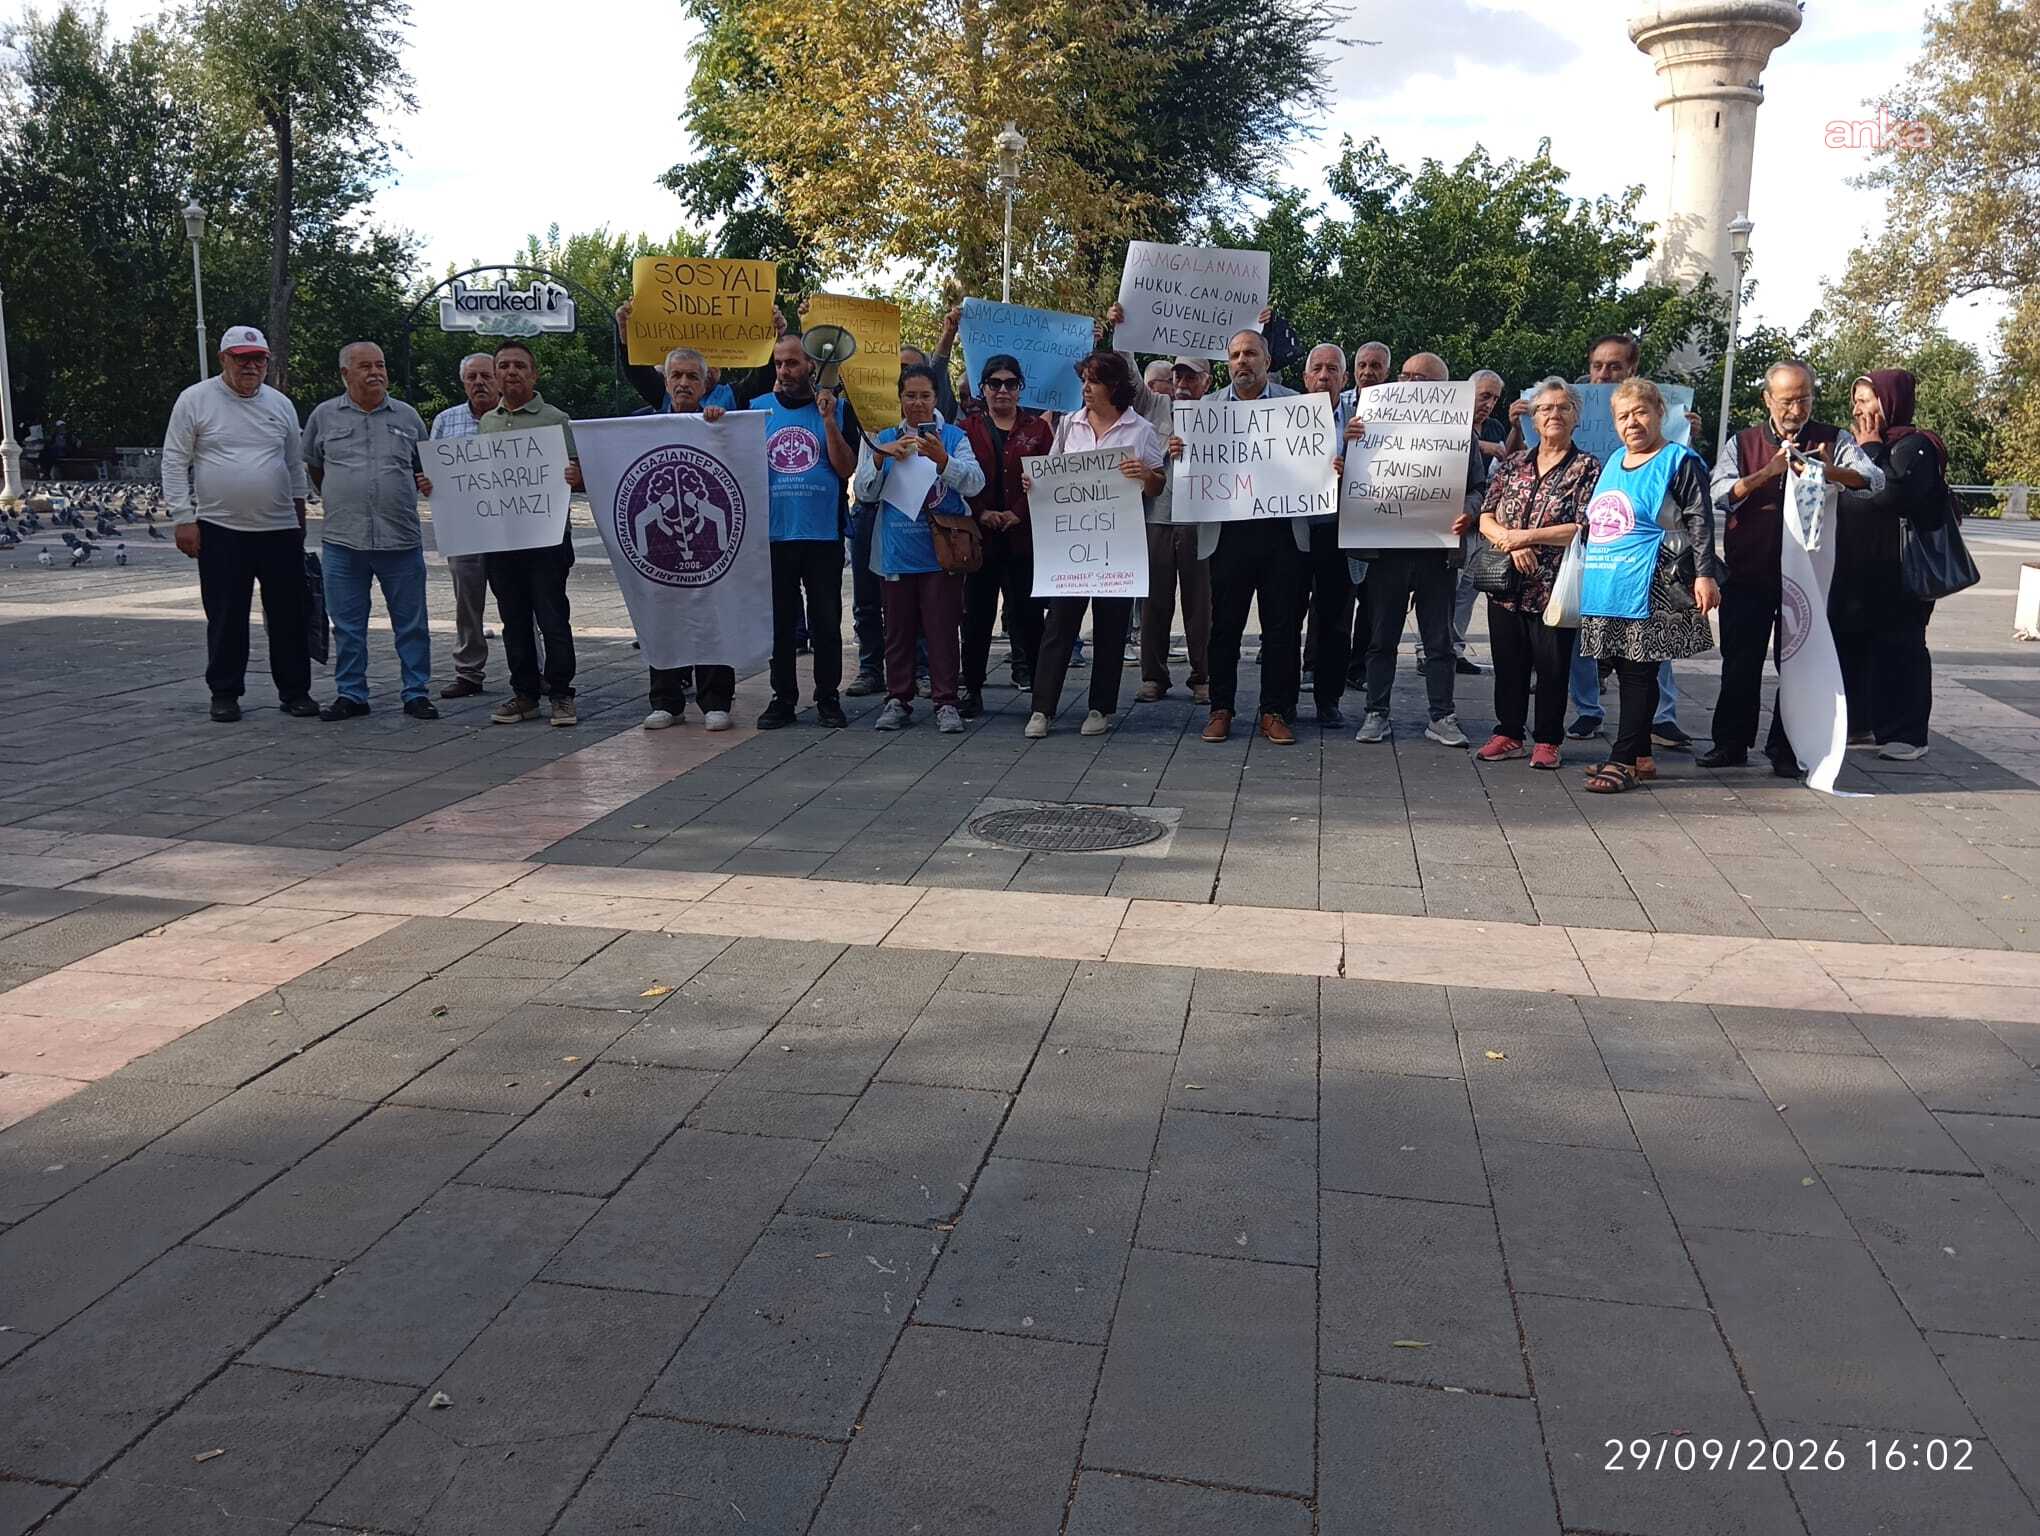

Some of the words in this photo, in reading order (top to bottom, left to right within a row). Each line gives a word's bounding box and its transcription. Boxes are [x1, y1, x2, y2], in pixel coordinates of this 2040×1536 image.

[1132, 247, 1261, 280] DAMGALANMAK
[654, 263, 770, 293] SOSYAL
[454, 285, 541, 311] karakedi
[1368, 387, 1457, 404] BAKLAVAYI
[1175, 405, 1276, 434] TADİLAT
[1284, 404, 1325, 429] YOK
[1362, 407, 1469, 426] BAKLAVACIDAN
[437, 436, 544, 466] SAĞLIKTA
[1179, 438, 1276, 465] TAHRİBAT
[1285, 432, 1325, 457] VAR
[1355, 432, 1407, 451] RUHSAL
[1410, 437, 1471, 454] HASTALIK
[639, 450, 713, 472] GAZİANTEP
[1370, 460, 1442, 479] TANISINI
[450, 464, 550, 493] TASARRUF
[1054, 479, 1120, 504] GÖNÜL
[1182, 472, 1254, 501] TRSM
[477, 493, 551, 518] OLMAZ!
[1252, 488, 1336, 516] AÇILSIN!
[1055, 507, 1116, 533] ELÇİSİ
